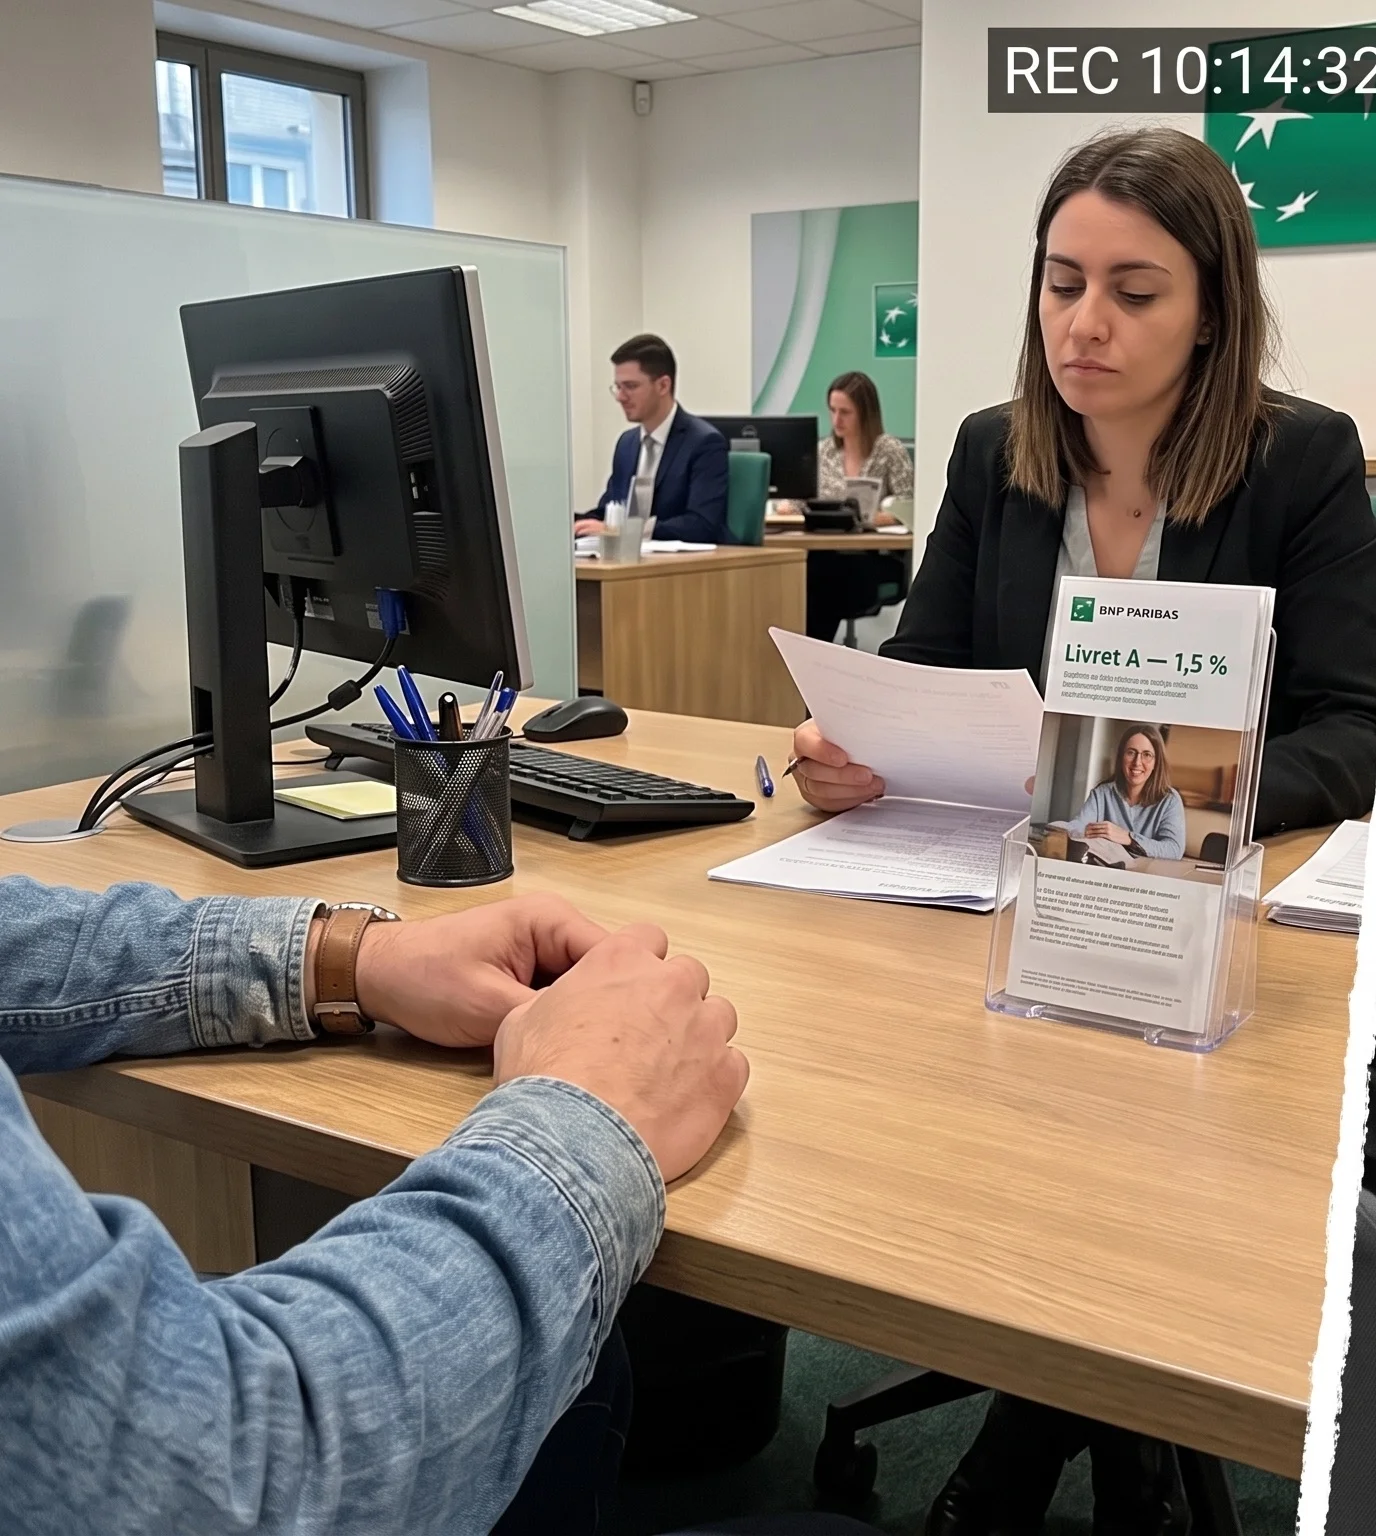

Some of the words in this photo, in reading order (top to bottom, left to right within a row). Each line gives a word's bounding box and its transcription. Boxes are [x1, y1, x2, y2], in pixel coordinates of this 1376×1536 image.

[1099, 605, 1125, 617] BNP
[1126, 607, 1180, 620] PARIBAS
[1064, 643, 1122, 667] Livret
[1125, 648, 1141, 668] A
[1174, 652, 1204, 677] 1,5
[1209, 654, 1229, 676] %
